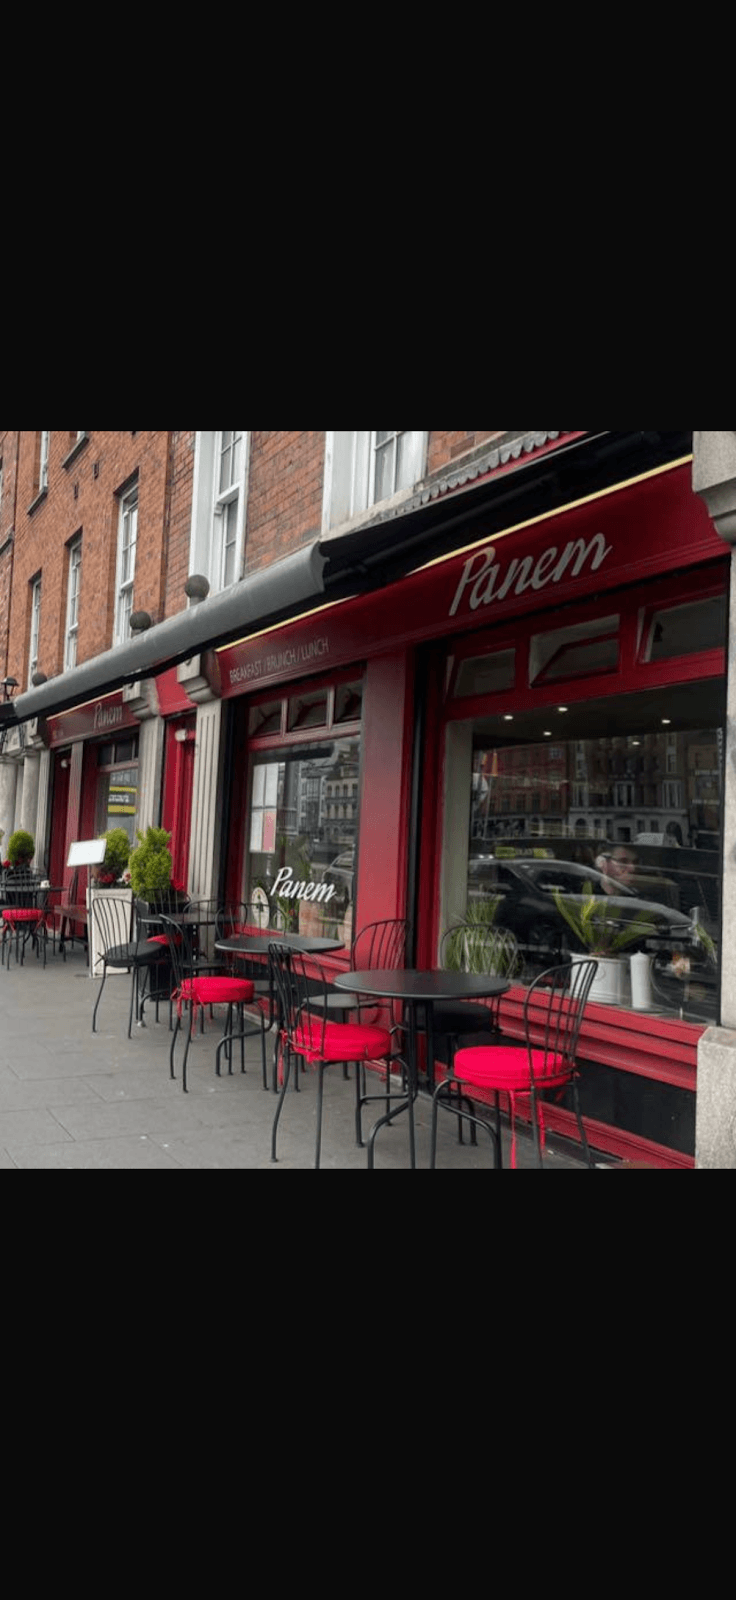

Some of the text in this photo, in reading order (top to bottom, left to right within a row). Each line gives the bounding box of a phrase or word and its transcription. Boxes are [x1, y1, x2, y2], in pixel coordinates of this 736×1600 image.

[448, 532, 613, 616] Panem
[229, 660, 262, 684] BREAKFAST
[266, 648, 296, 671] BRUNCH
[301, 637, 329, 660] LUNCH
[270, 866, 337, 903] Panem
